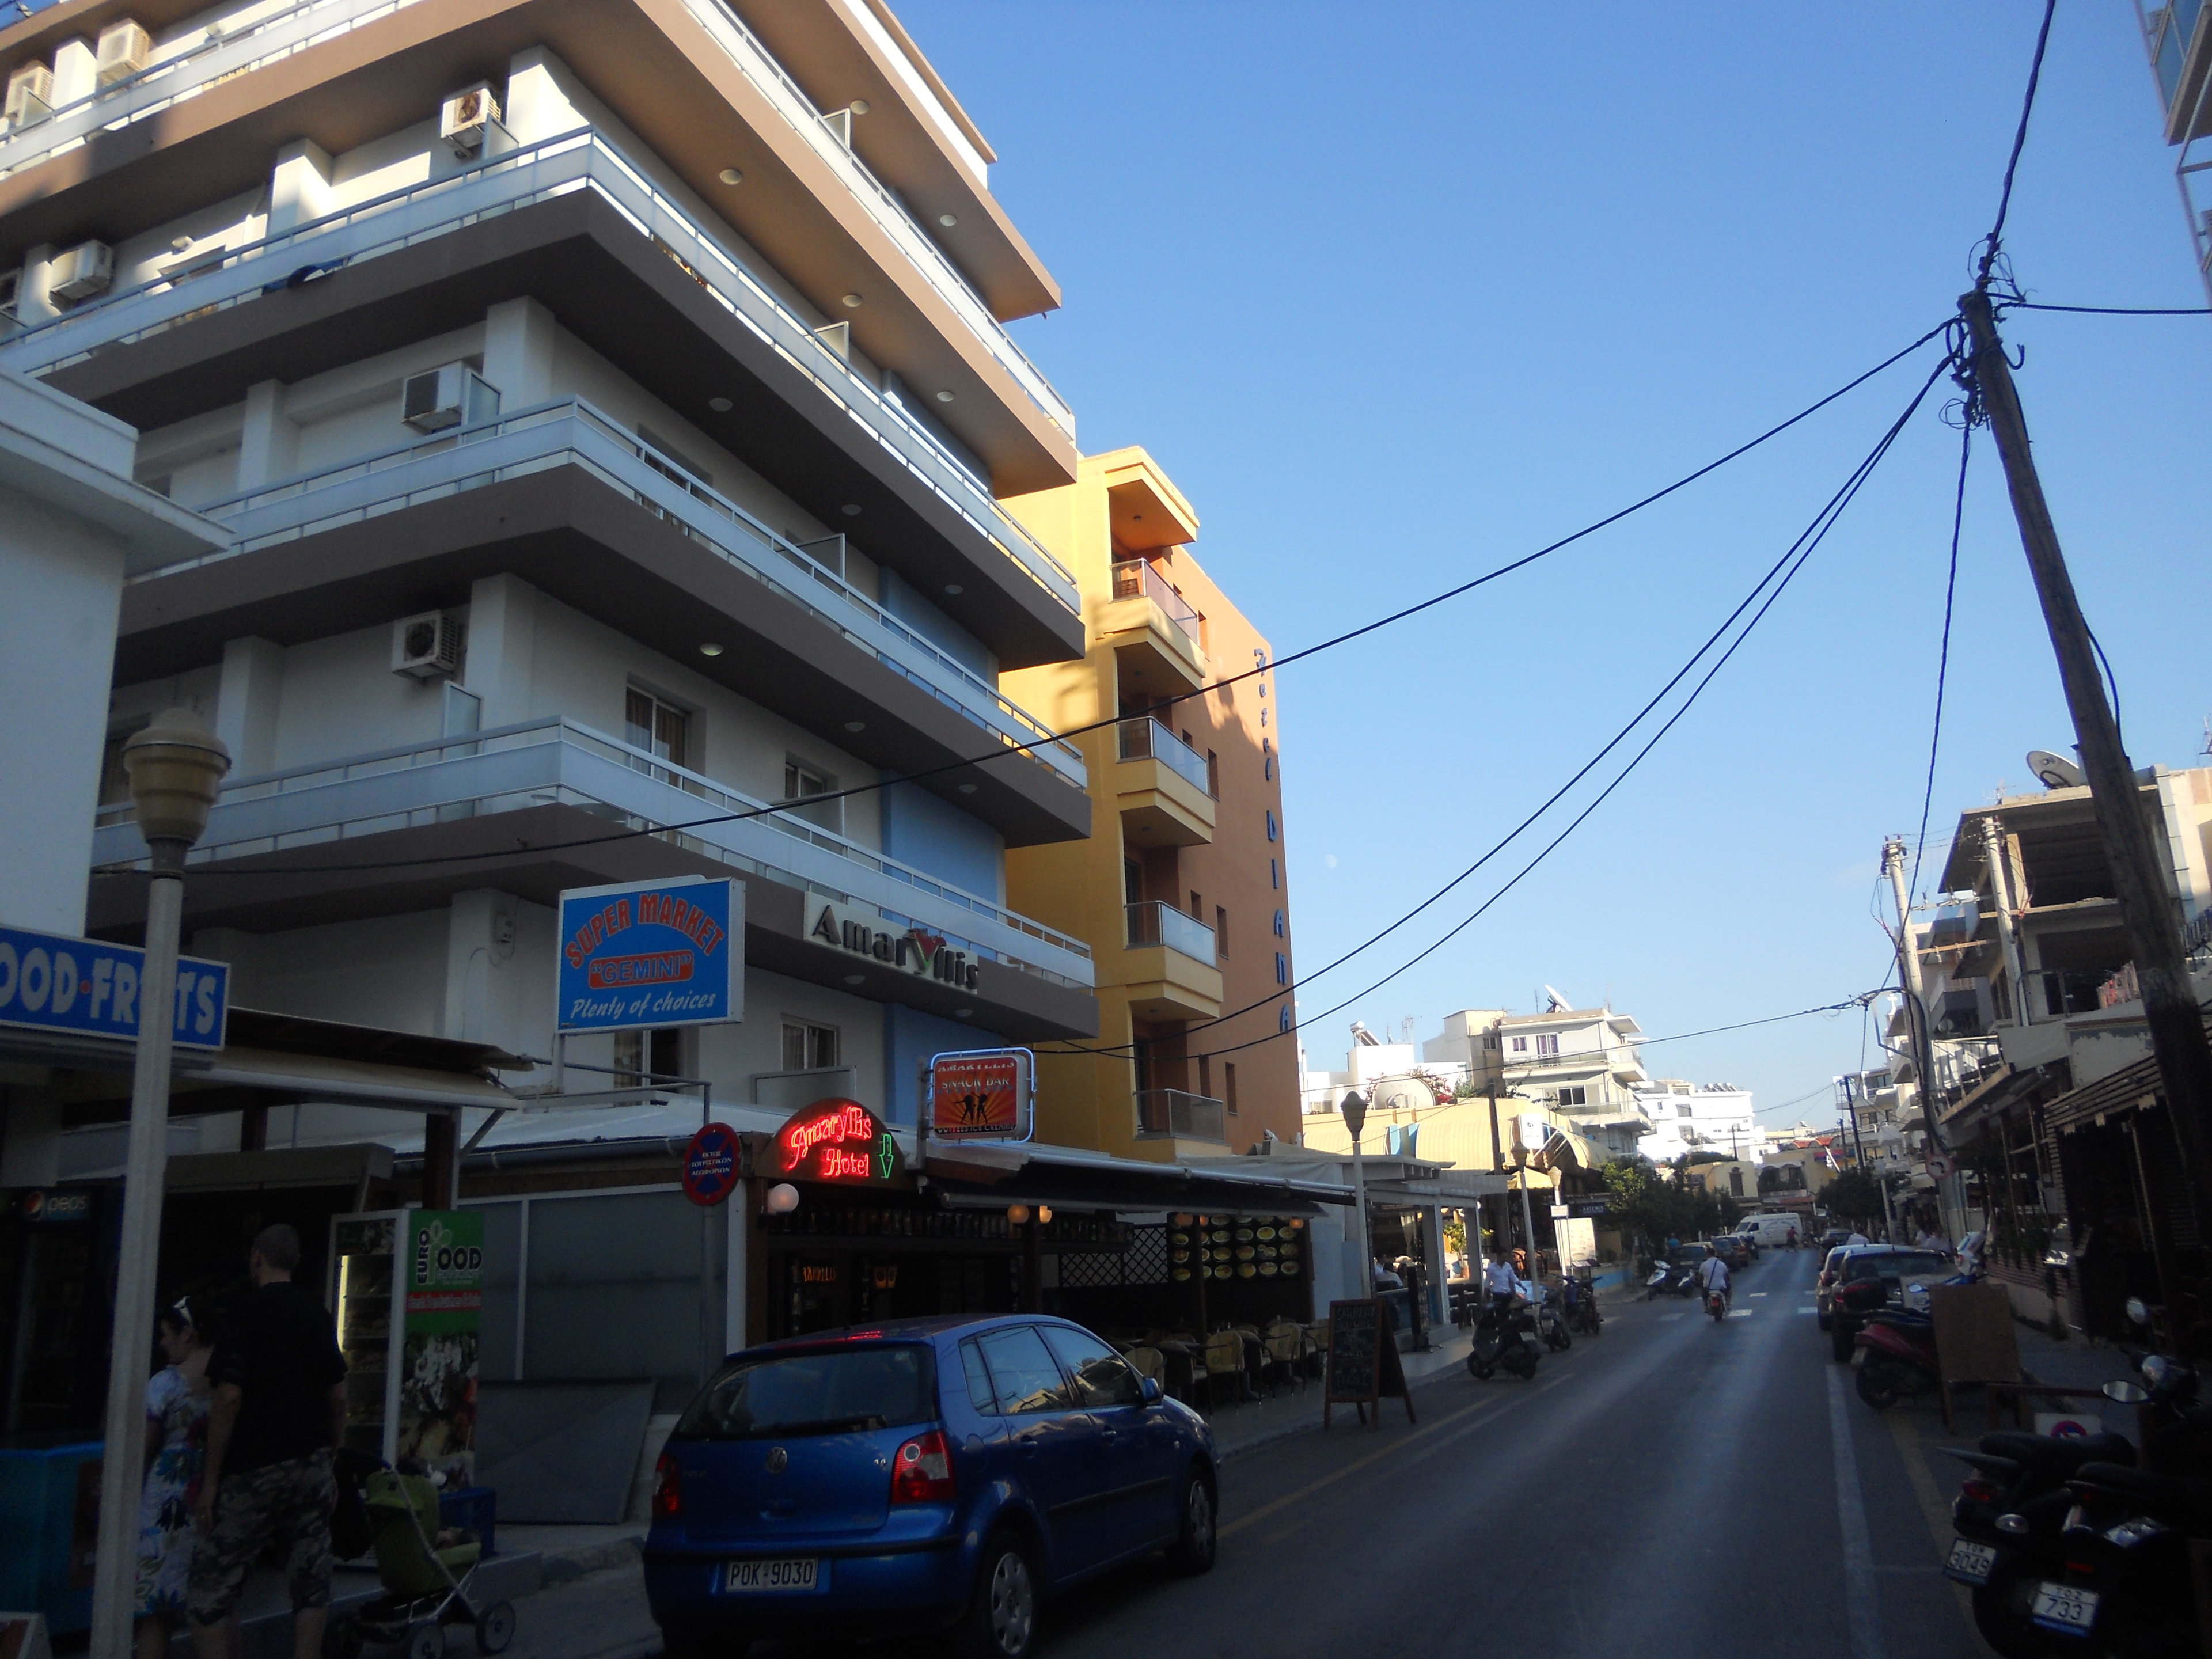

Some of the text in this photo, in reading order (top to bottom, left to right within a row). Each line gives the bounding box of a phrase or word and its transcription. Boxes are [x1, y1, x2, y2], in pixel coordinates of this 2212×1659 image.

[566, 894, 725, 969] SUPER MARKET
[1266, 810, 1290, 1034] DIANA
[90, 958, 217, 1034] FRTS
[571, 990, 716, 1020] Plenty of choices
[823, 1148, 870, 1178] Hotel
[416, 1228, 430, 1284] EURO
[2045, 1597, 2082, 1620] 733
